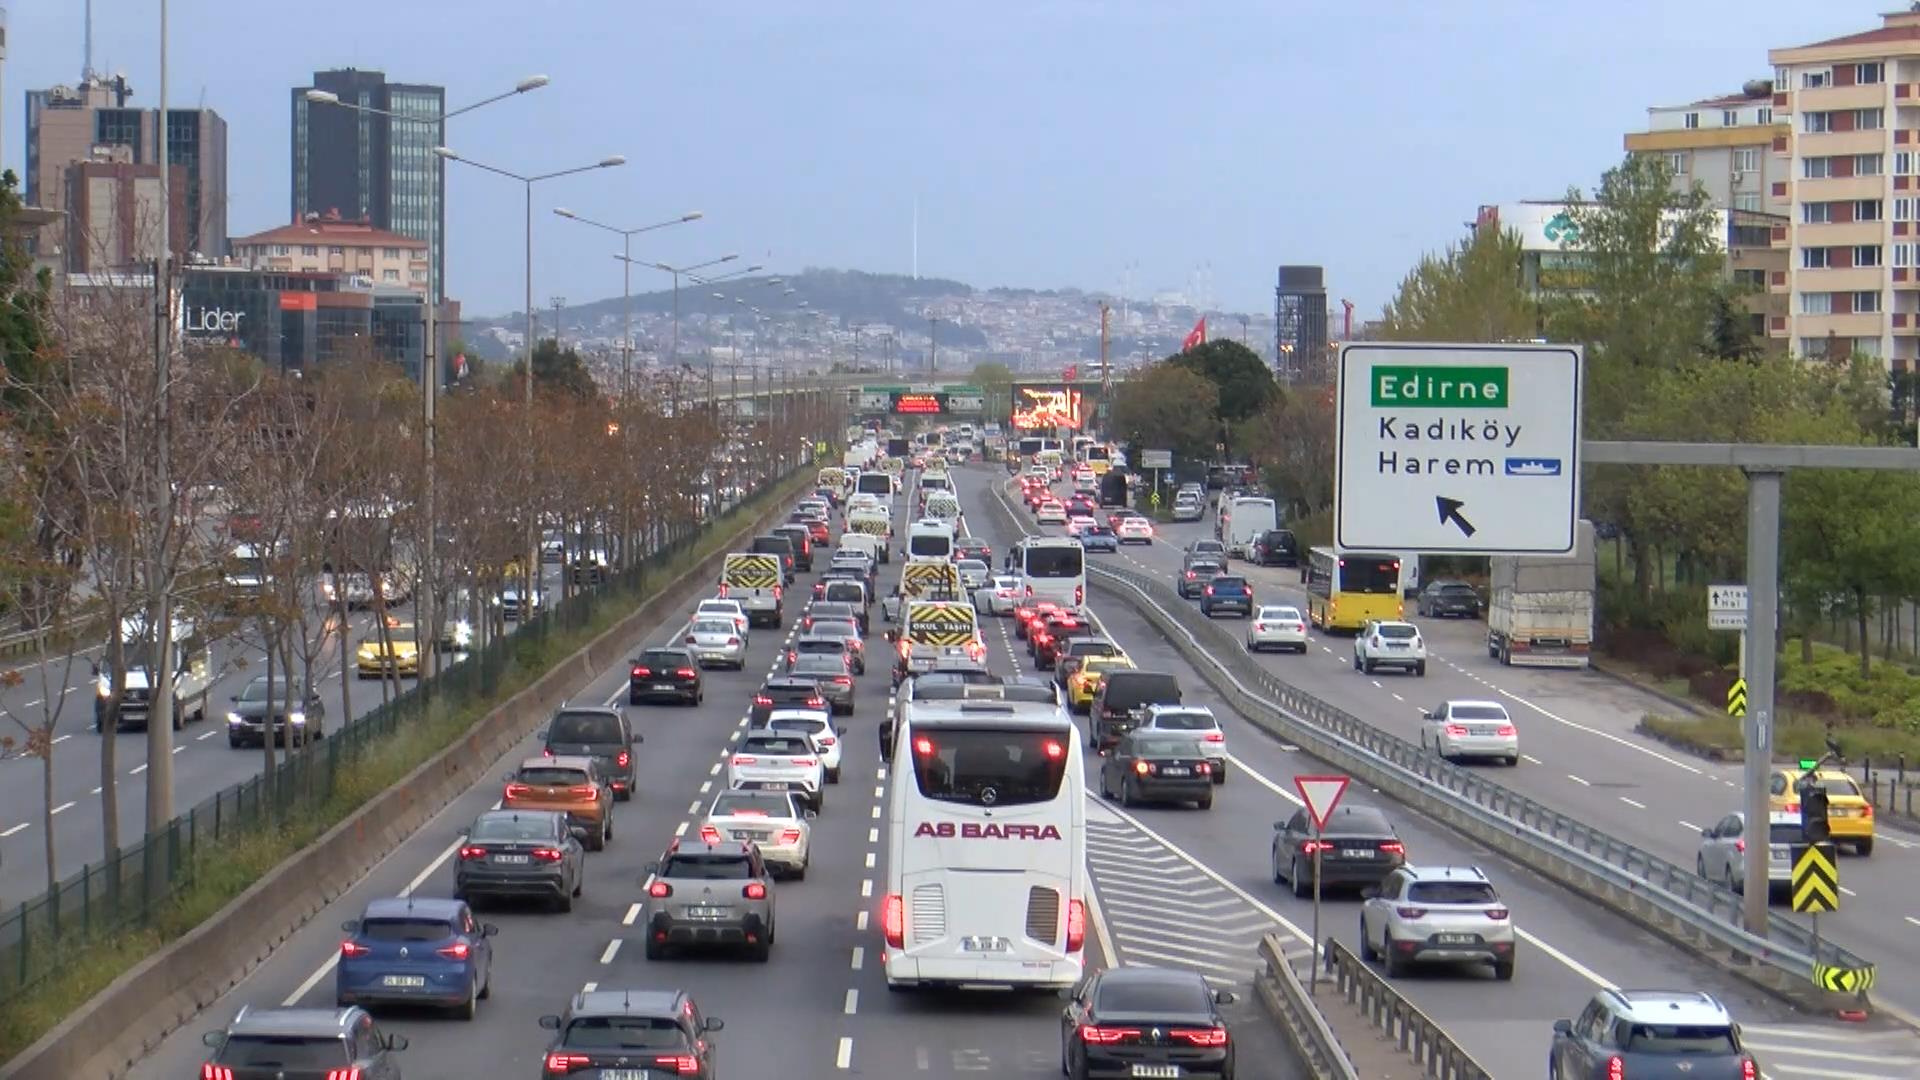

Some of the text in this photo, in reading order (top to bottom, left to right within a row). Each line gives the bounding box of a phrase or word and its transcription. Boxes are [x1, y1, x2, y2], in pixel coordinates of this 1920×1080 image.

[186, 306, 246, 332] Lider
[1379, 374, 1499, 400] Edirne
[1379, 417, 1521, 448] Kadıköy
[1378, 451, 1495, 475] Harem
[912, 622, 972, 633] OKUL TAŞITI
[961, 822, 1062, 840] BAFRA
